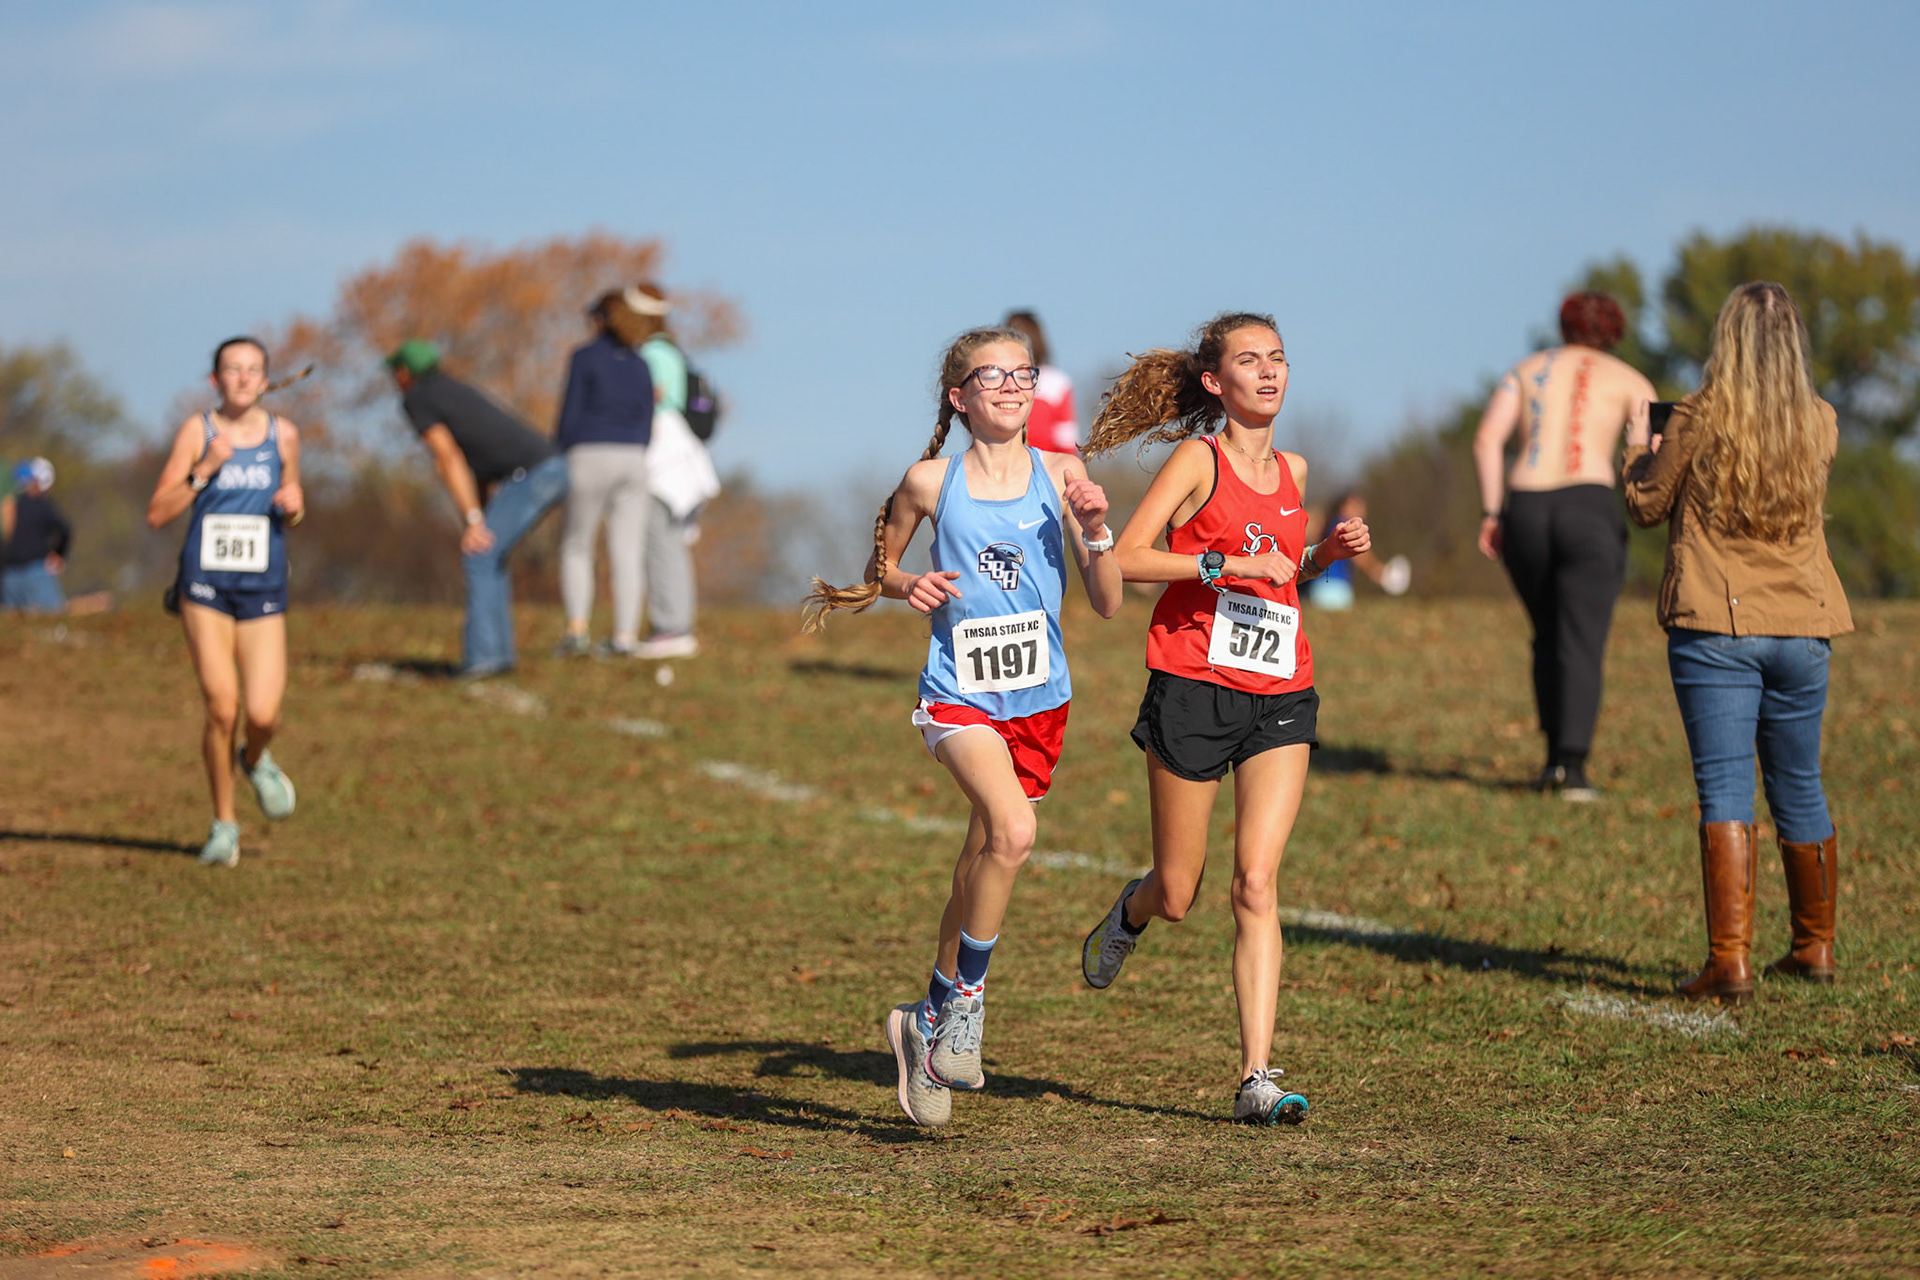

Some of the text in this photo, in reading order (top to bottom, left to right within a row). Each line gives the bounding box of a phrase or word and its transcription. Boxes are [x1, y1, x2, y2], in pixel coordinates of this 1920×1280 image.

[215, 536, 256, 560] 581
[979, 552, 1019, 590] SBA
[1228, 600, 1291, 625] TMSAA STATE XC
[963, 620, 1039, 639] TMSAA STATE XC
[1229, 621, 1280, 664] 572
[966, 639, 1037, 681] 1197
